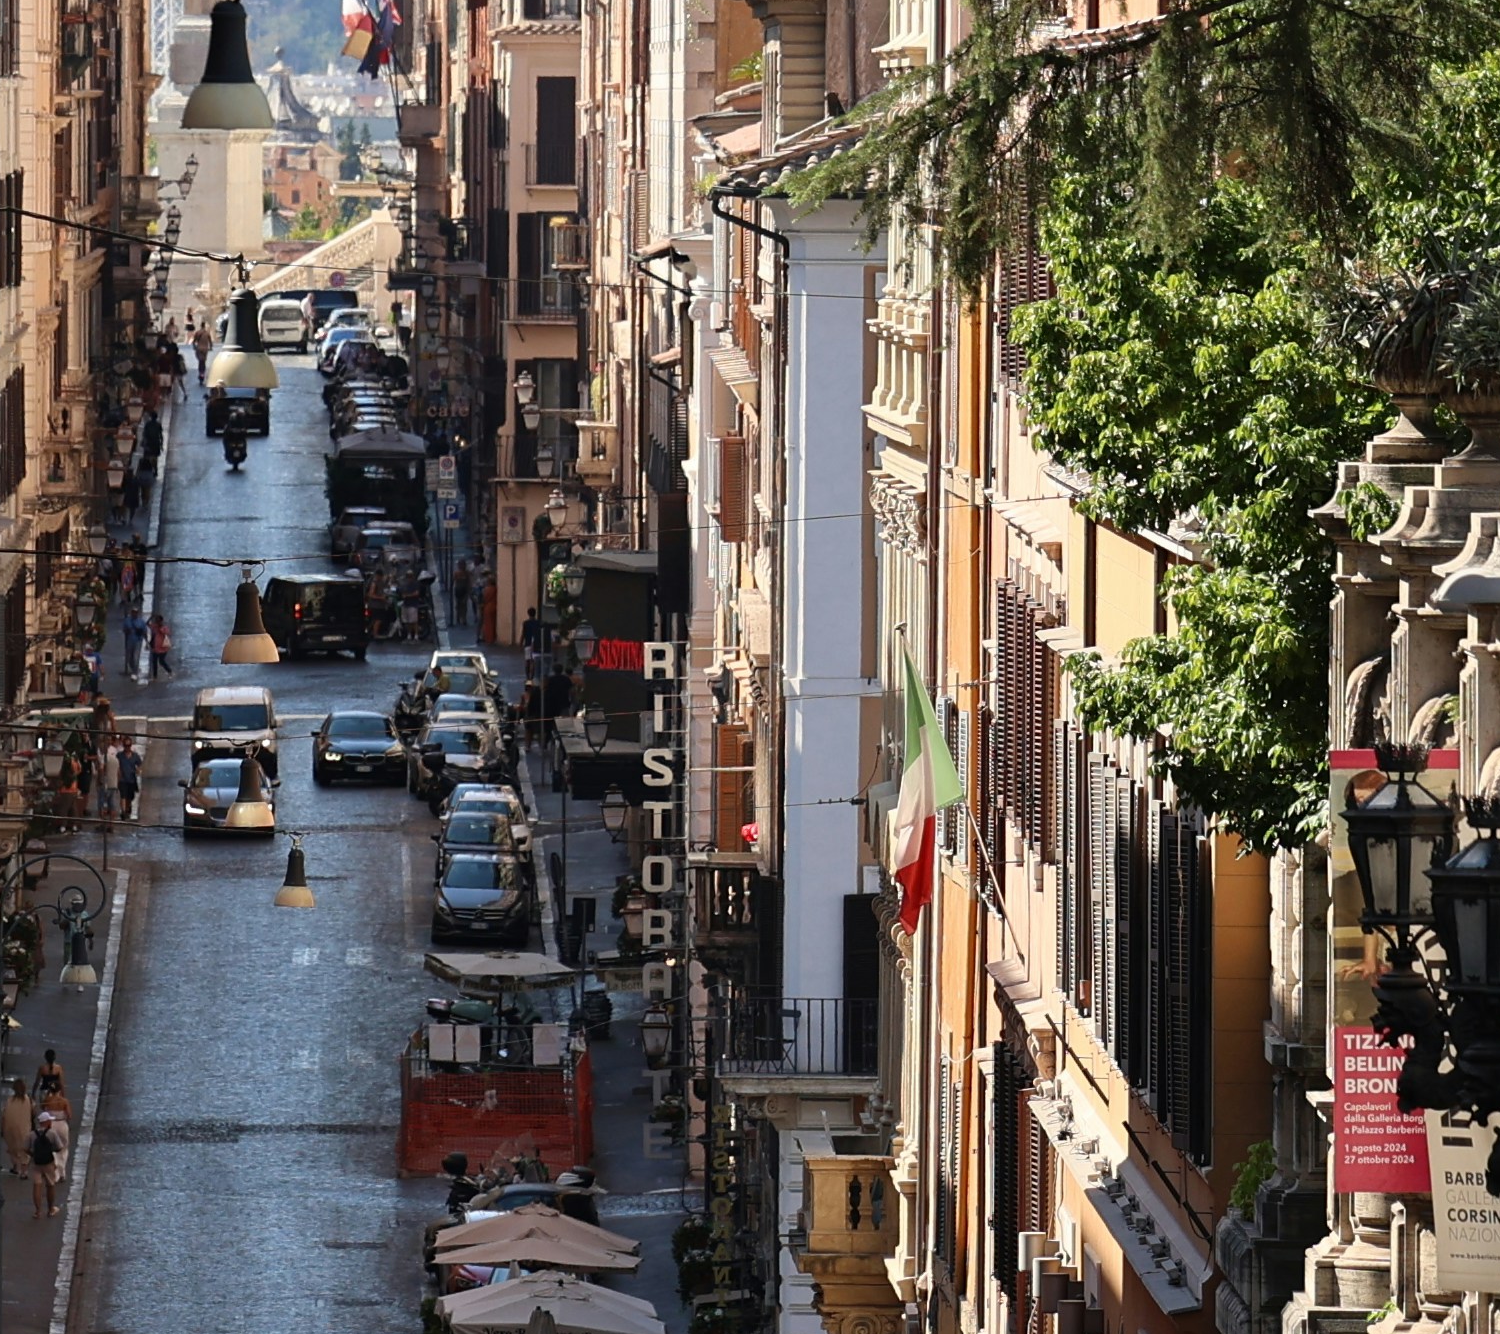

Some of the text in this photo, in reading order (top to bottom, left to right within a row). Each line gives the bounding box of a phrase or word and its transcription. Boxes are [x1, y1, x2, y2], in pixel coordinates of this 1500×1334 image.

[1343, 1102, 1392, 1113] Capolavori
[1343, 1113, 1366, 1123] dalla
[1367, 1113, 1401, 1123] Galleria
[1351, 1125, 1384, 1135] Palazzo
[1386, 1125, 1425, 1135] Barberini
[1352, 1144, 1382, 1154] agosto
[1383, 1143, 1407, 1152] 2024
[1344, 1155, 1415, 1164] 27 ottobre 2024
